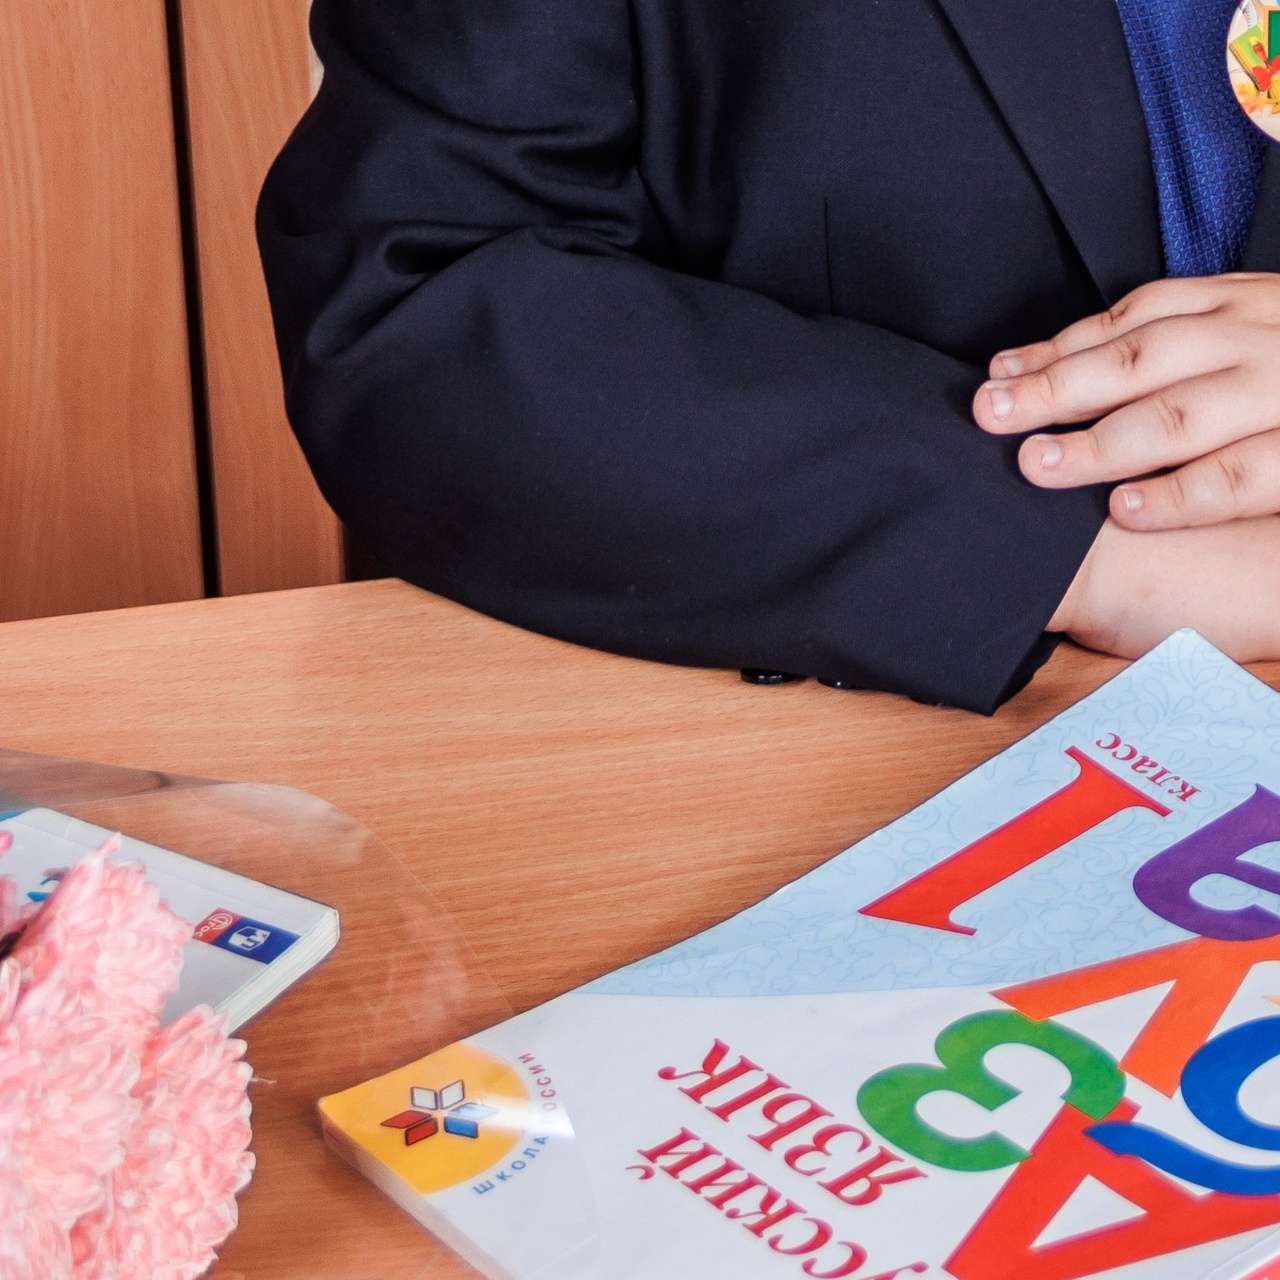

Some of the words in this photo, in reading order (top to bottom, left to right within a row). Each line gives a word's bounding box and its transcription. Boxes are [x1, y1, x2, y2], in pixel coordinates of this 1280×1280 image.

[1095, 731, 1201, 802] класс
[473, 1136, 549, 1194] ШКОЛА
[518, 1052, 557, 1124] ОССИИ
[657, 1037, 929, 1207] ЯЗЫК
